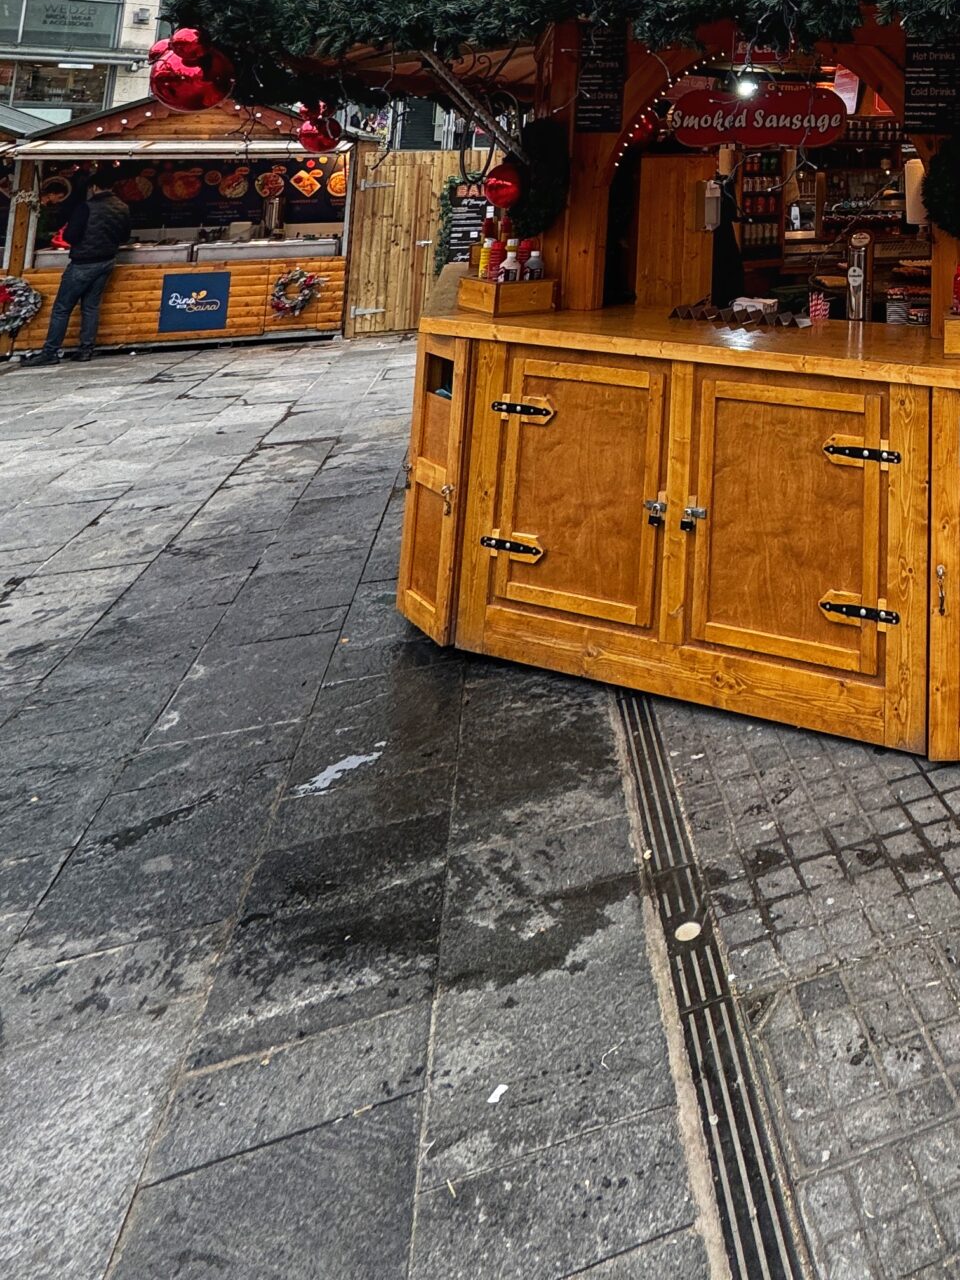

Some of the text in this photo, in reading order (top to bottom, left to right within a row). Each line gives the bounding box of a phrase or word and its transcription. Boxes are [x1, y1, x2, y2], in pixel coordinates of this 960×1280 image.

[912, 51, 956, 61] Hot Drinks
[910, 87, 957, 96] Cold Drinks
[672, 108, 842, 134] Smoked Sausage
